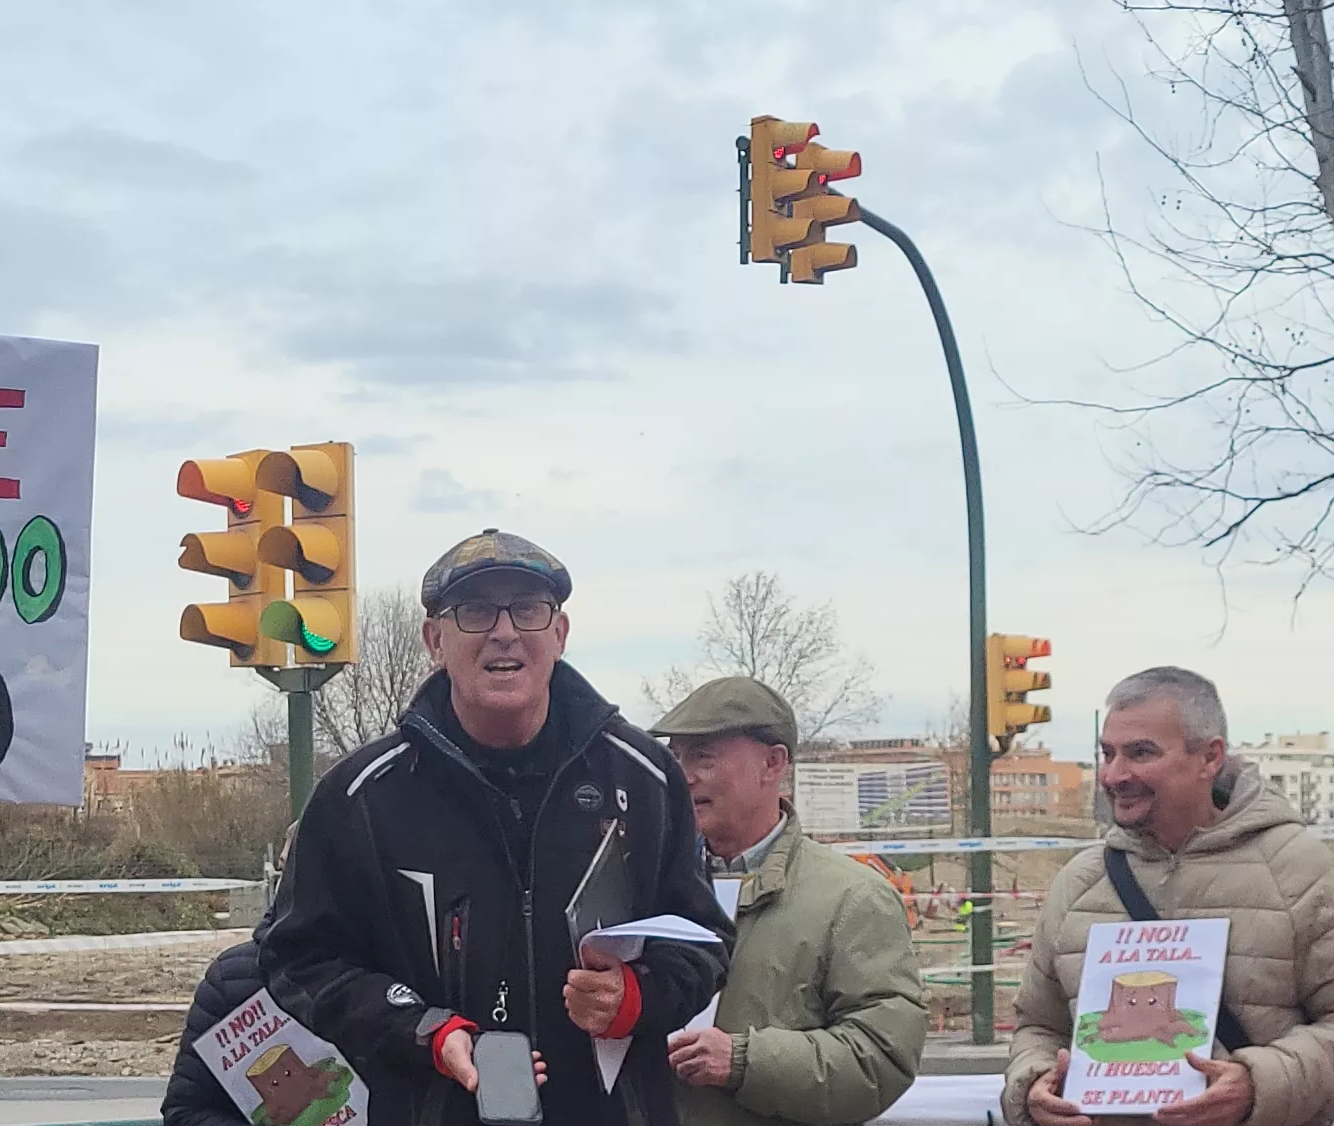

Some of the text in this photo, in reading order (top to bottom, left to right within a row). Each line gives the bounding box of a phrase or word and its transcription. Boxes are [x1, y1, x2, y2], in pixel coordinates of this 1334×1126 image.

[1098, 950, 1112, 964] A
[1116, 949, 1141, 963] LA
[221, 1056, 233, 1071] A
[230, 1042, 251, 1063] LA
[1103, 1062, 1180, 1078] HUESCA
[1080, 1088, 1185, 1106] SE PLANTA
